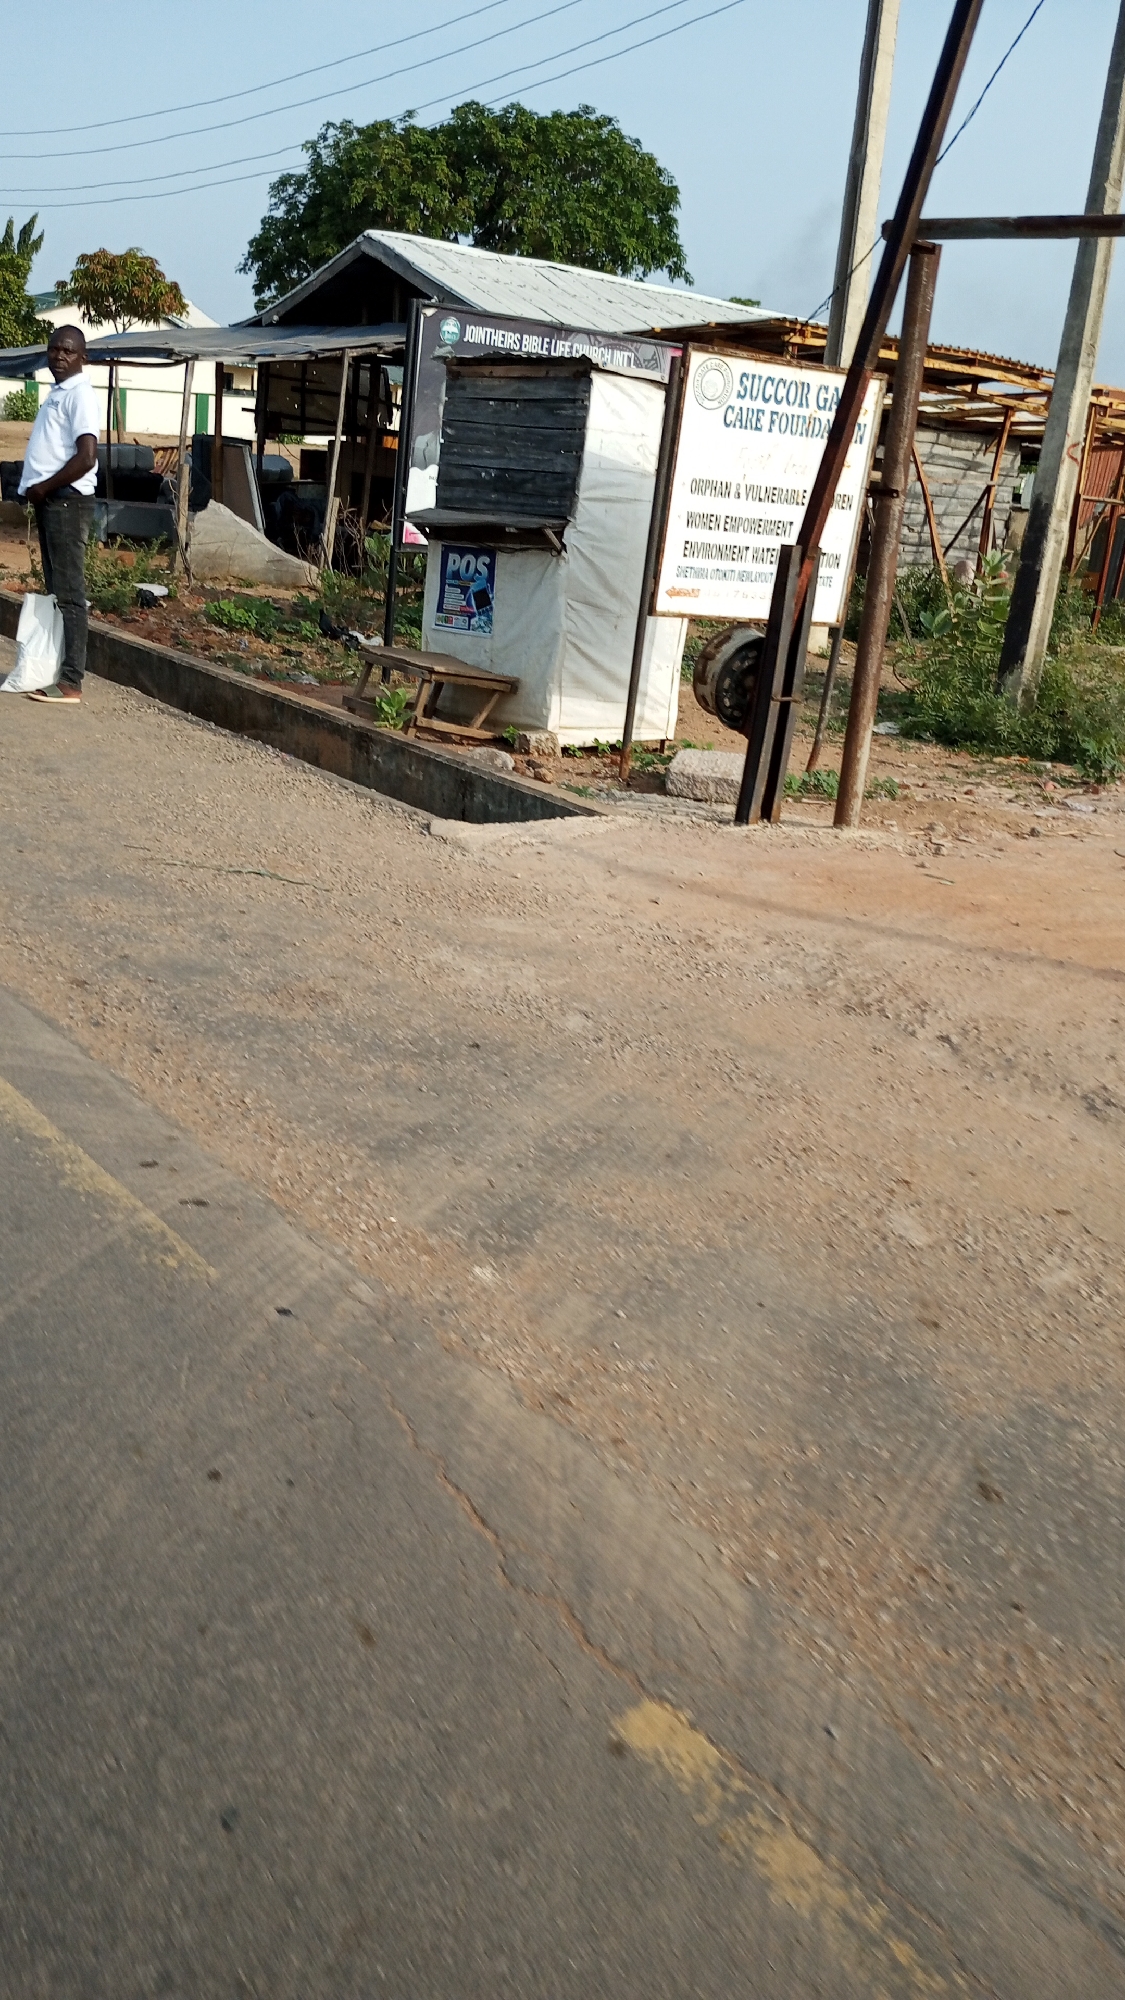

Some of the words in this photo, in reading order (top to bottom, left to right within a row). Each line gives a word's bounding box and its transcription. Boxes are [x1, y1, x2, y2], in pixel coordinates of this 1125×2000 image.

[463, 324, 521, 351] JOINTHEIRS
[522, 334, 549, 356] BIBLE
[551, 339, 573, 358] LIFE
[573, 343, 612, 364] CHURCH
[613, 349, 636, 369] INT'L
[736, 371, 811, 409] SUCCOR
[816, 384, 843, 412] GA
[723, 405, 765, 432] CARE
[768, 410, 867, 445] FOUNDAN
[690, 478, 732, 499] ORPHAN
[734, 483, 741, 499] &
[744, 484, 807, 506] VULNERABLE
[686, 511, 721, 531] WOMEN
[723, 516, 794, 539] EMPOWERMENT
[446, 552, 491, 581] POS
